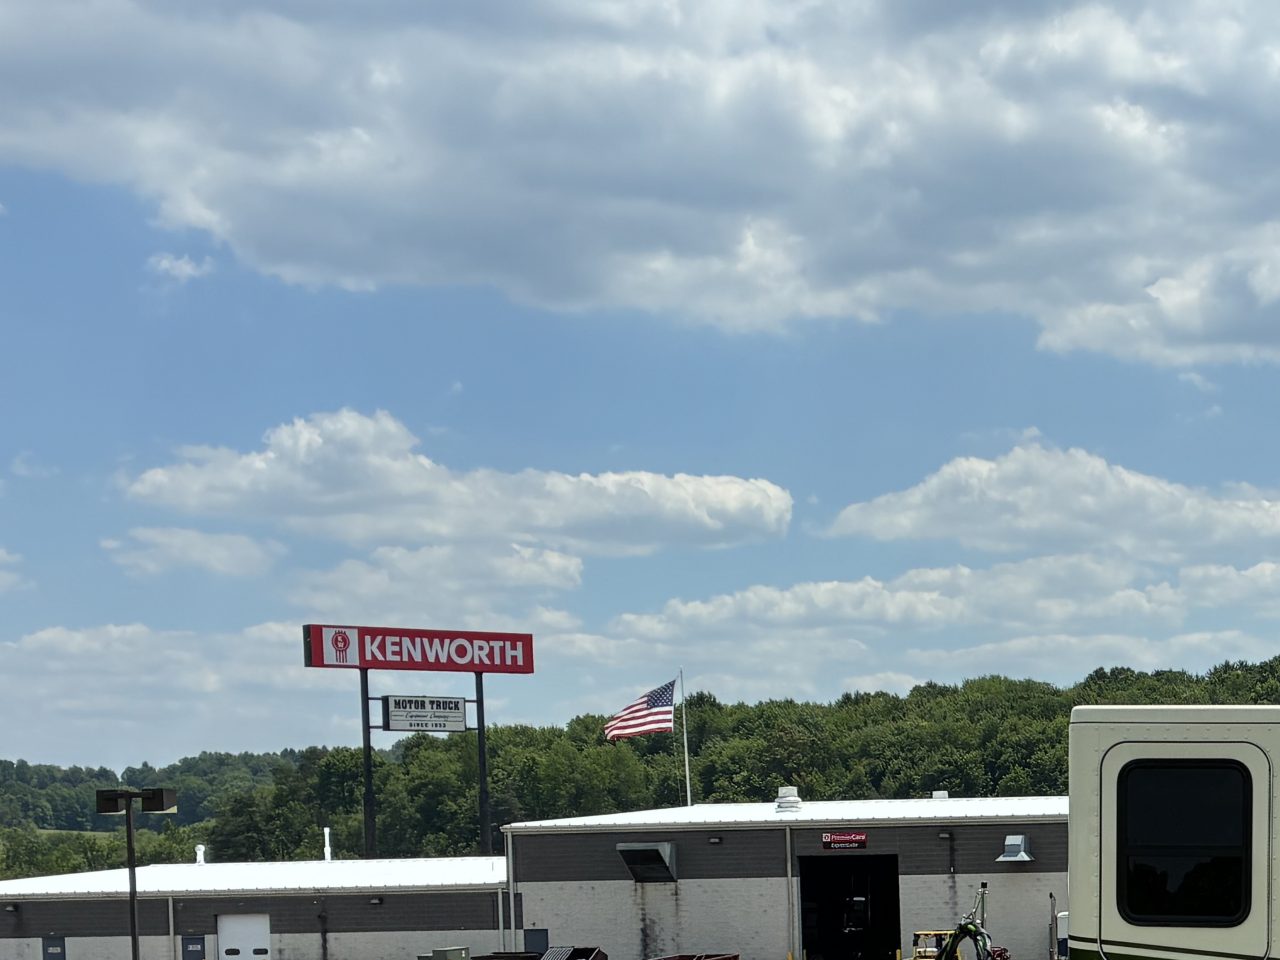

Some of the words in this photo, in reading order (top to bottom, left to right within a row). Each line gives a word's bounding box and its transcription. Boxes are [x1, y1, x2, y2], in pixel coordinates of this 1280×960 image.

[364, 634, 524, 666] KENWORTH
[394, 699, 425, 710] MOTOR
[429, 701, 460, 711] TRUCK
